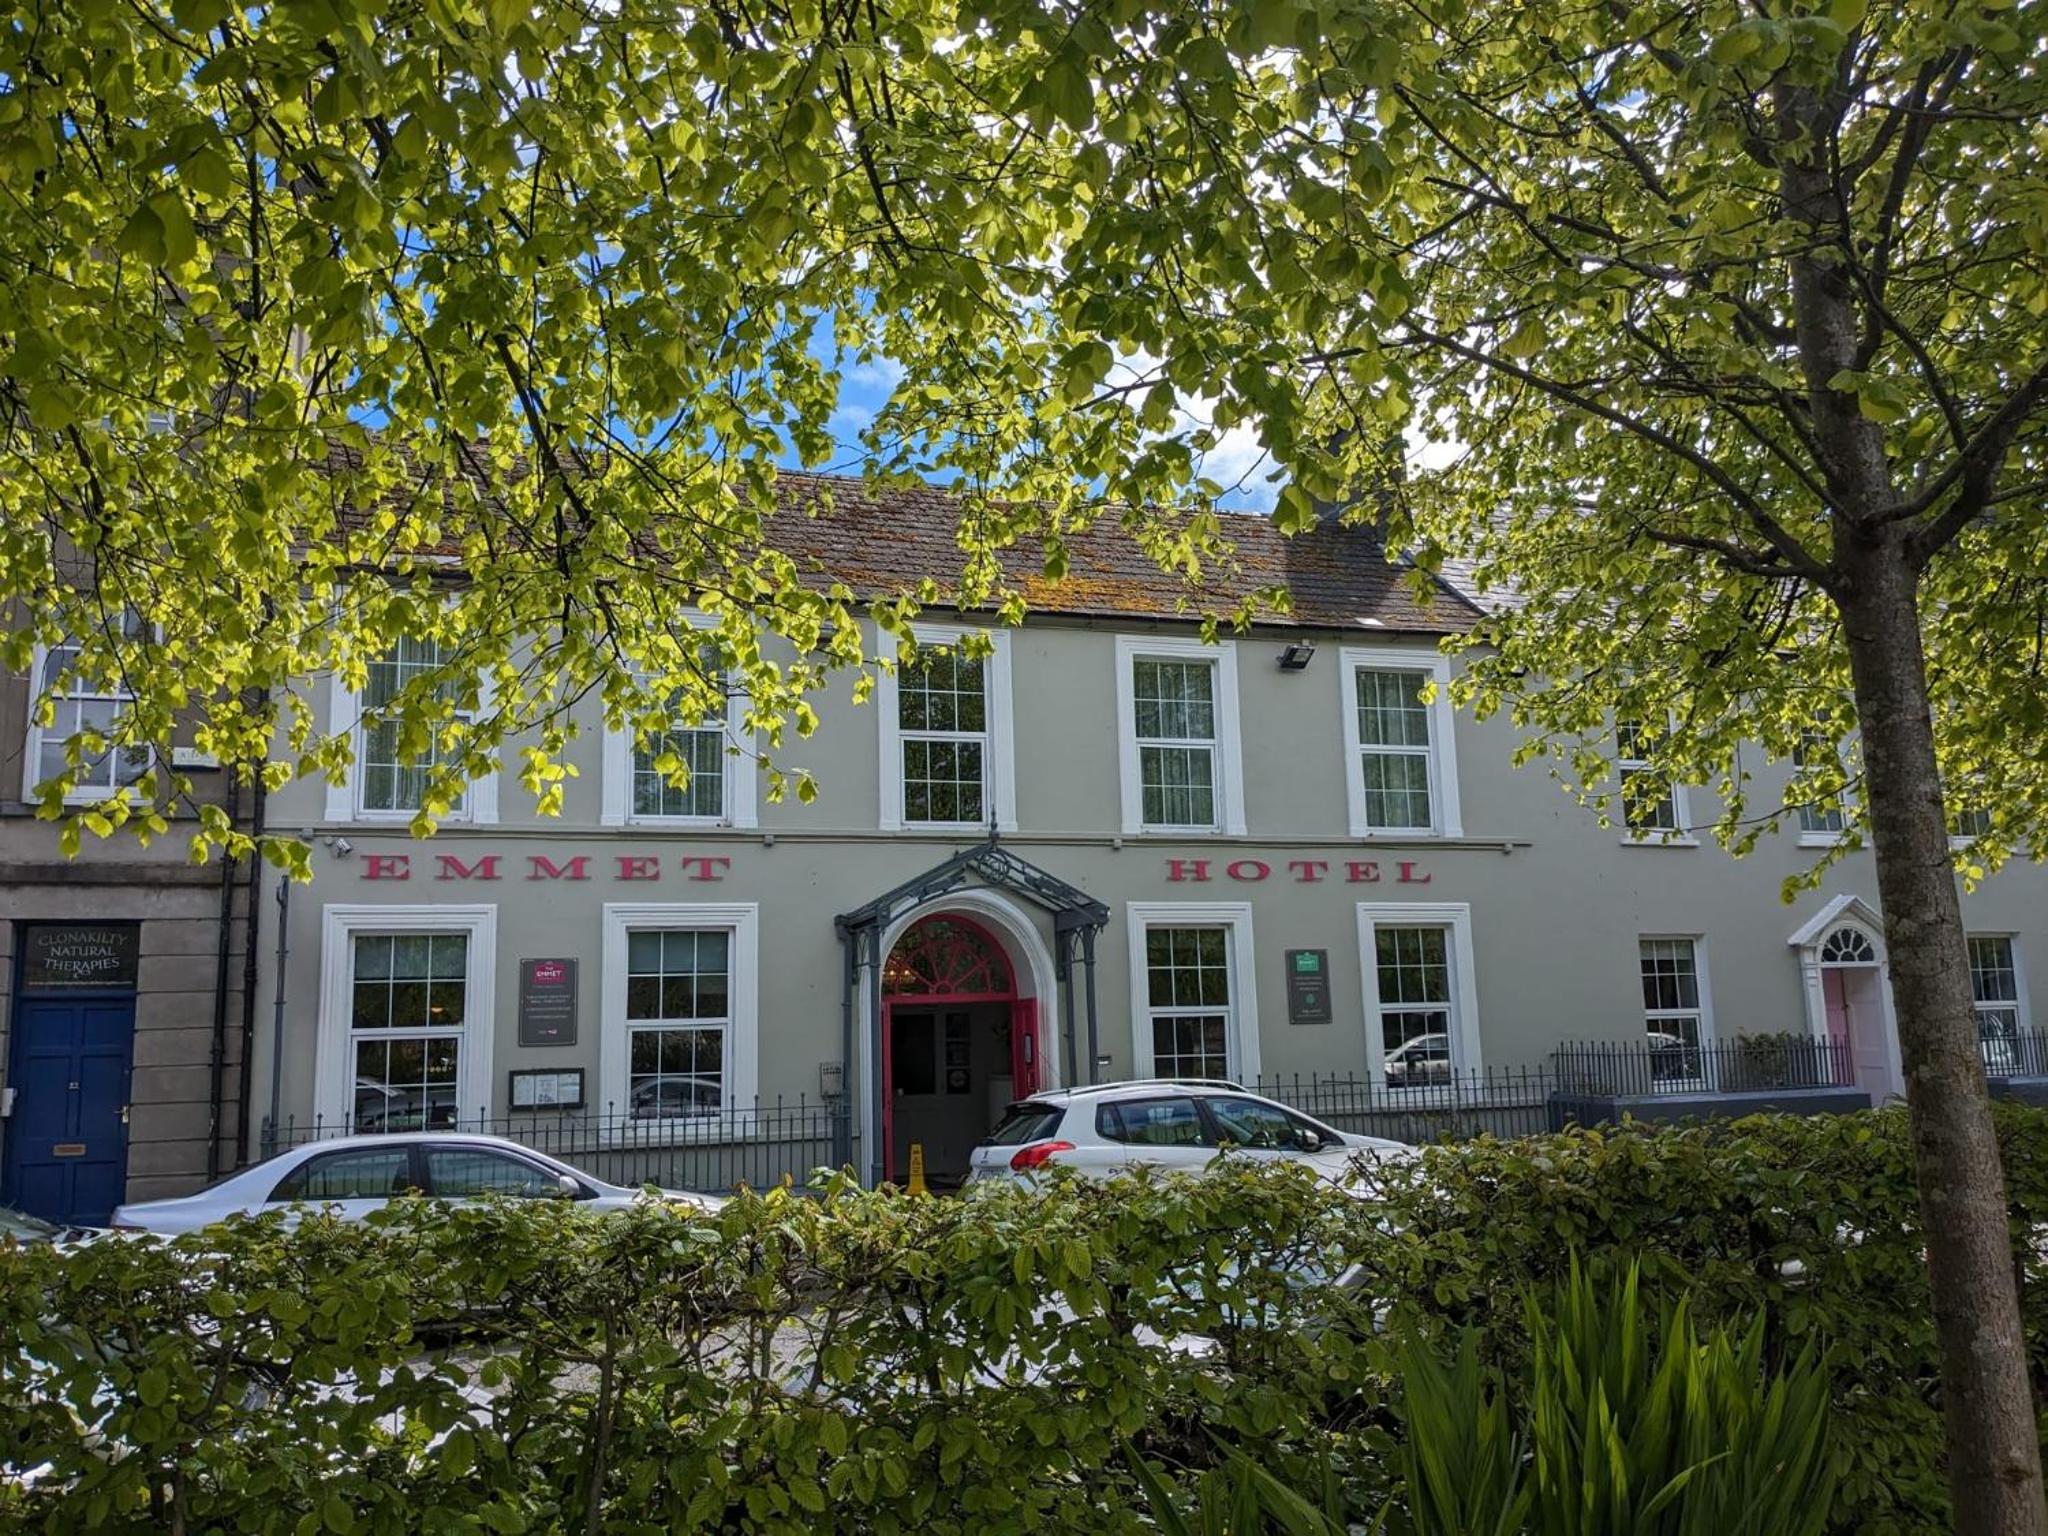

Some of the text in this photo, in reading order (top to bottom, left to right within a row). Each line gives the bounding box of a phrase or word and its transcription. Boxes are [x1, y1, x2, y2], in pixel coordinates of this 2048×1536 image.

[359, 854, 731, 881] EMMET
[1165, 859, 1432, 883] HOTEL
[38, 931, 128, 946] CLONAKILTY
[50, 945, 114, 957] NATURAL
[43, 956, 120, 972] THERAPIES
